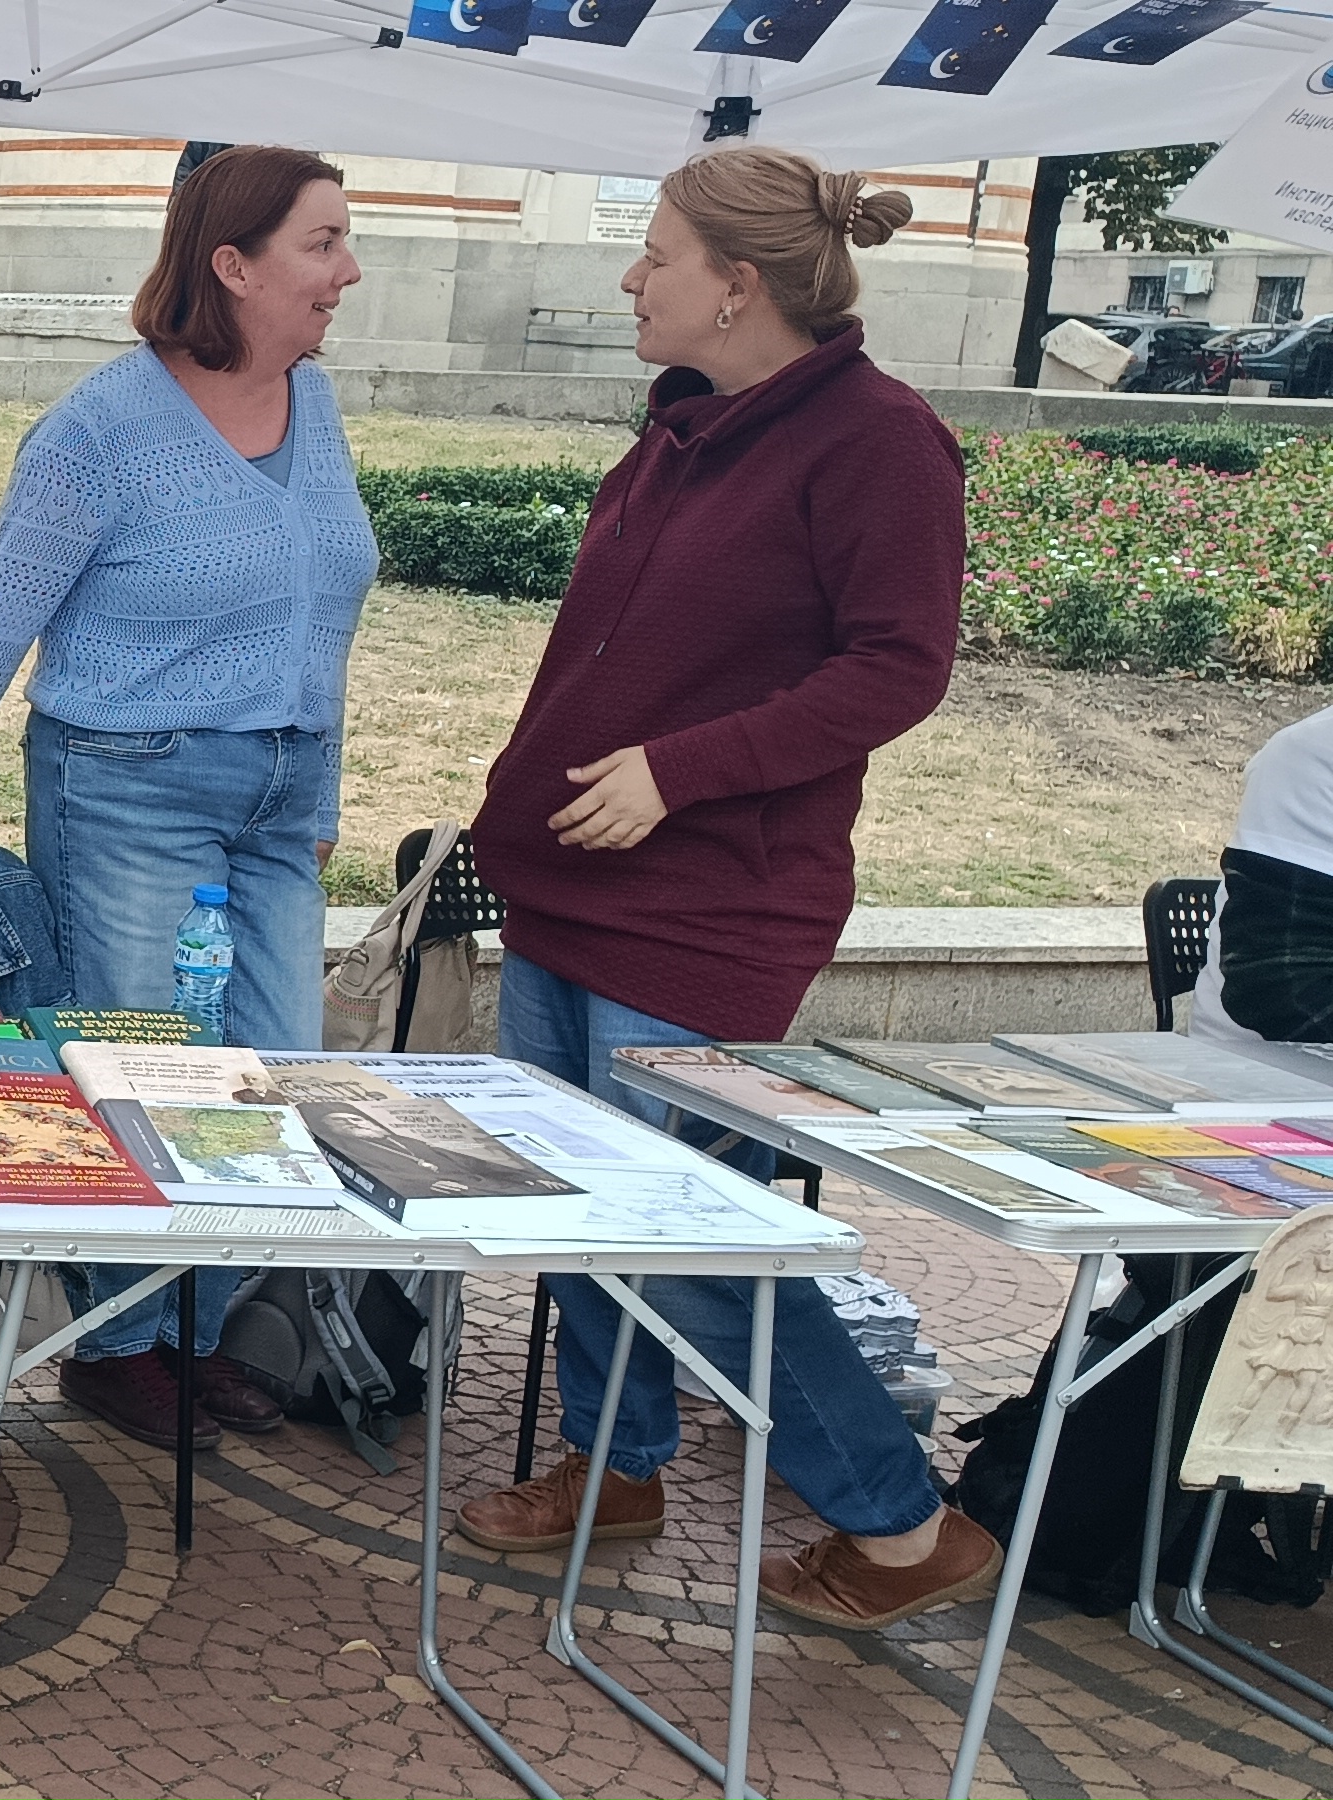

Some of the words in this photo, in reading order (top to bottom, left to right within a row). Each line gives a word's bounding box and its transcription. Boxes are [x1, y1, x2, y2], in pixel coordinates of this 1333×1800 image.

[56, 1010, 96, 1019] КЪМ
[100, 1010, 188, 1022] КОРЕНИТЕ
[54, 1020, 79, 1028] НА
[82, 1019, 202, 1032] БЪЛГАРСКОТО
